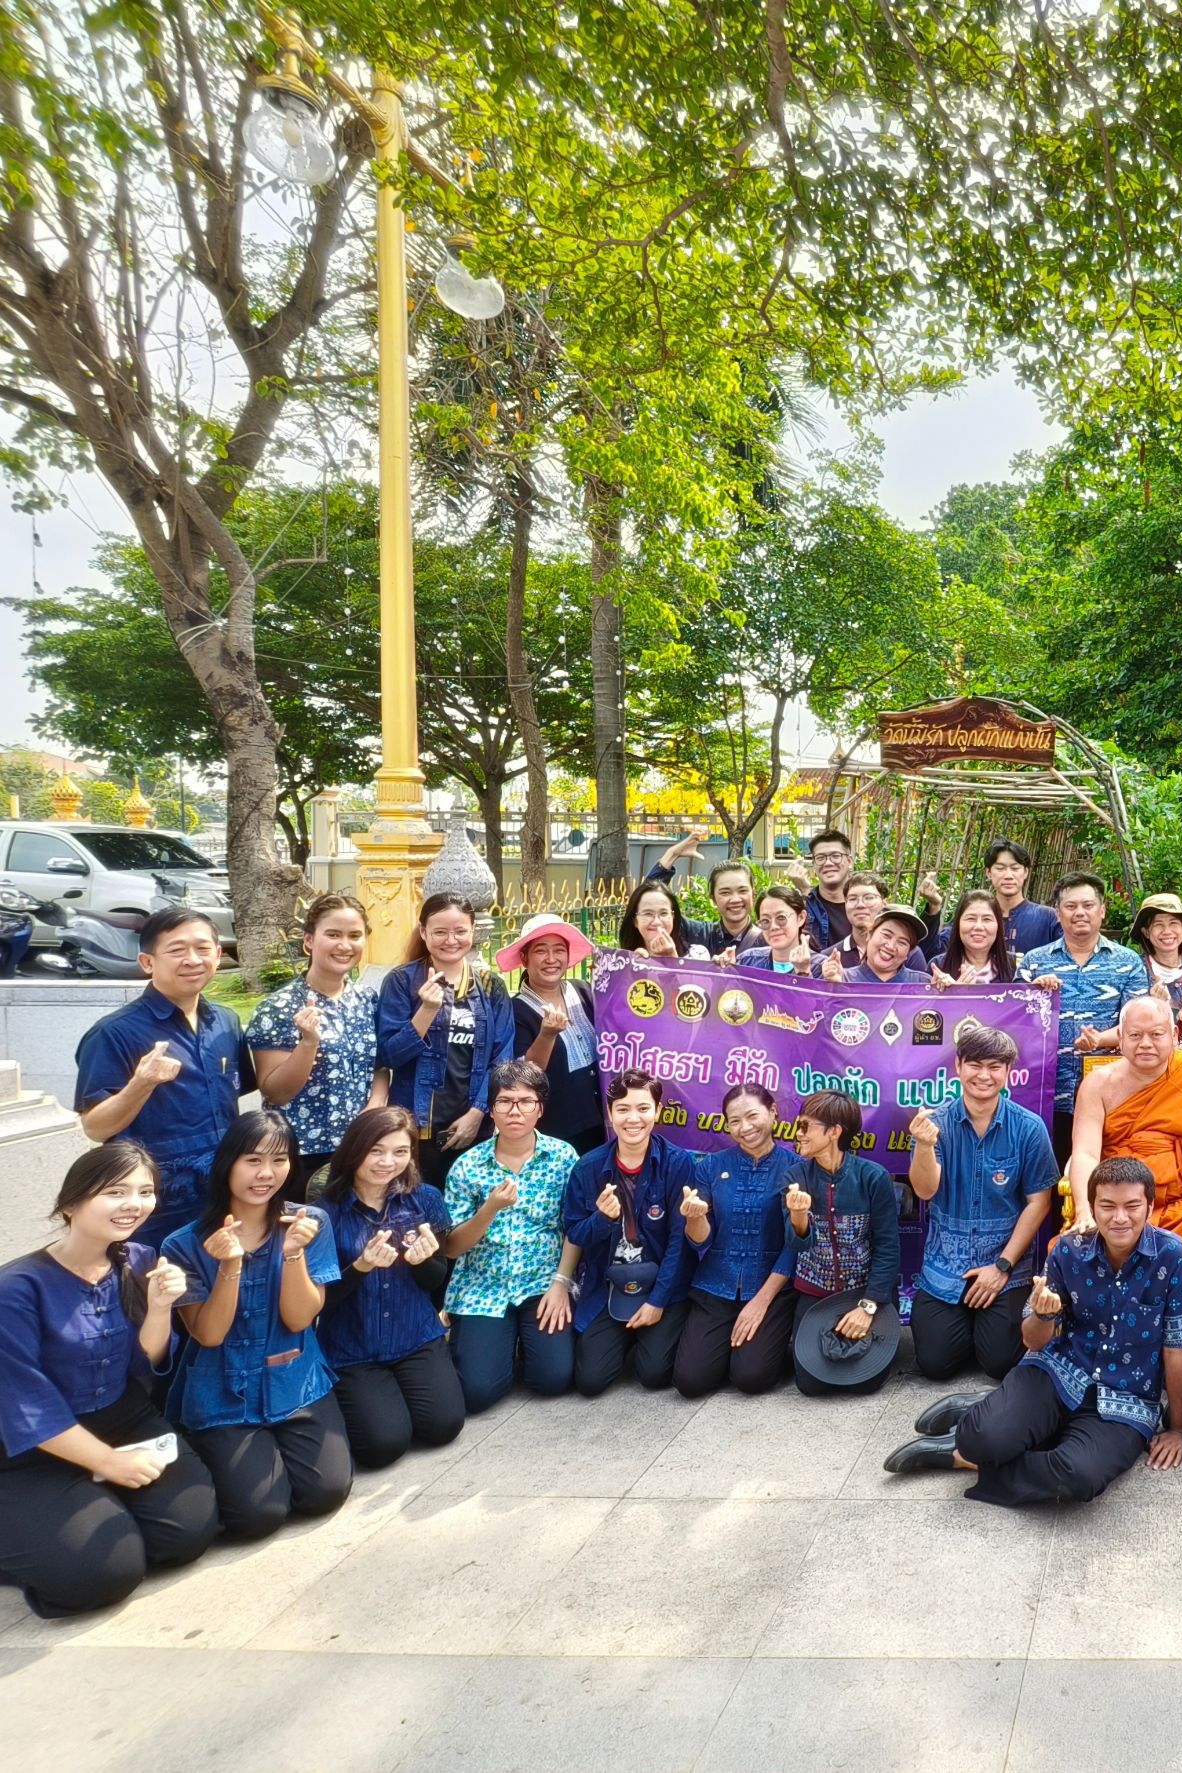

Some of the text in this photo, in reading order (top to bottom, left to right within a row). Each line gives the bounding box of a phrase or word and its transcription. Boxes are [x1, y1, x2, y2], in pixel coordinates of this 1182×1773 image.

[597, 1031, 712, 1084] วัดโสธรฯ
[725, 1046, 780, 1092] มีรัก
